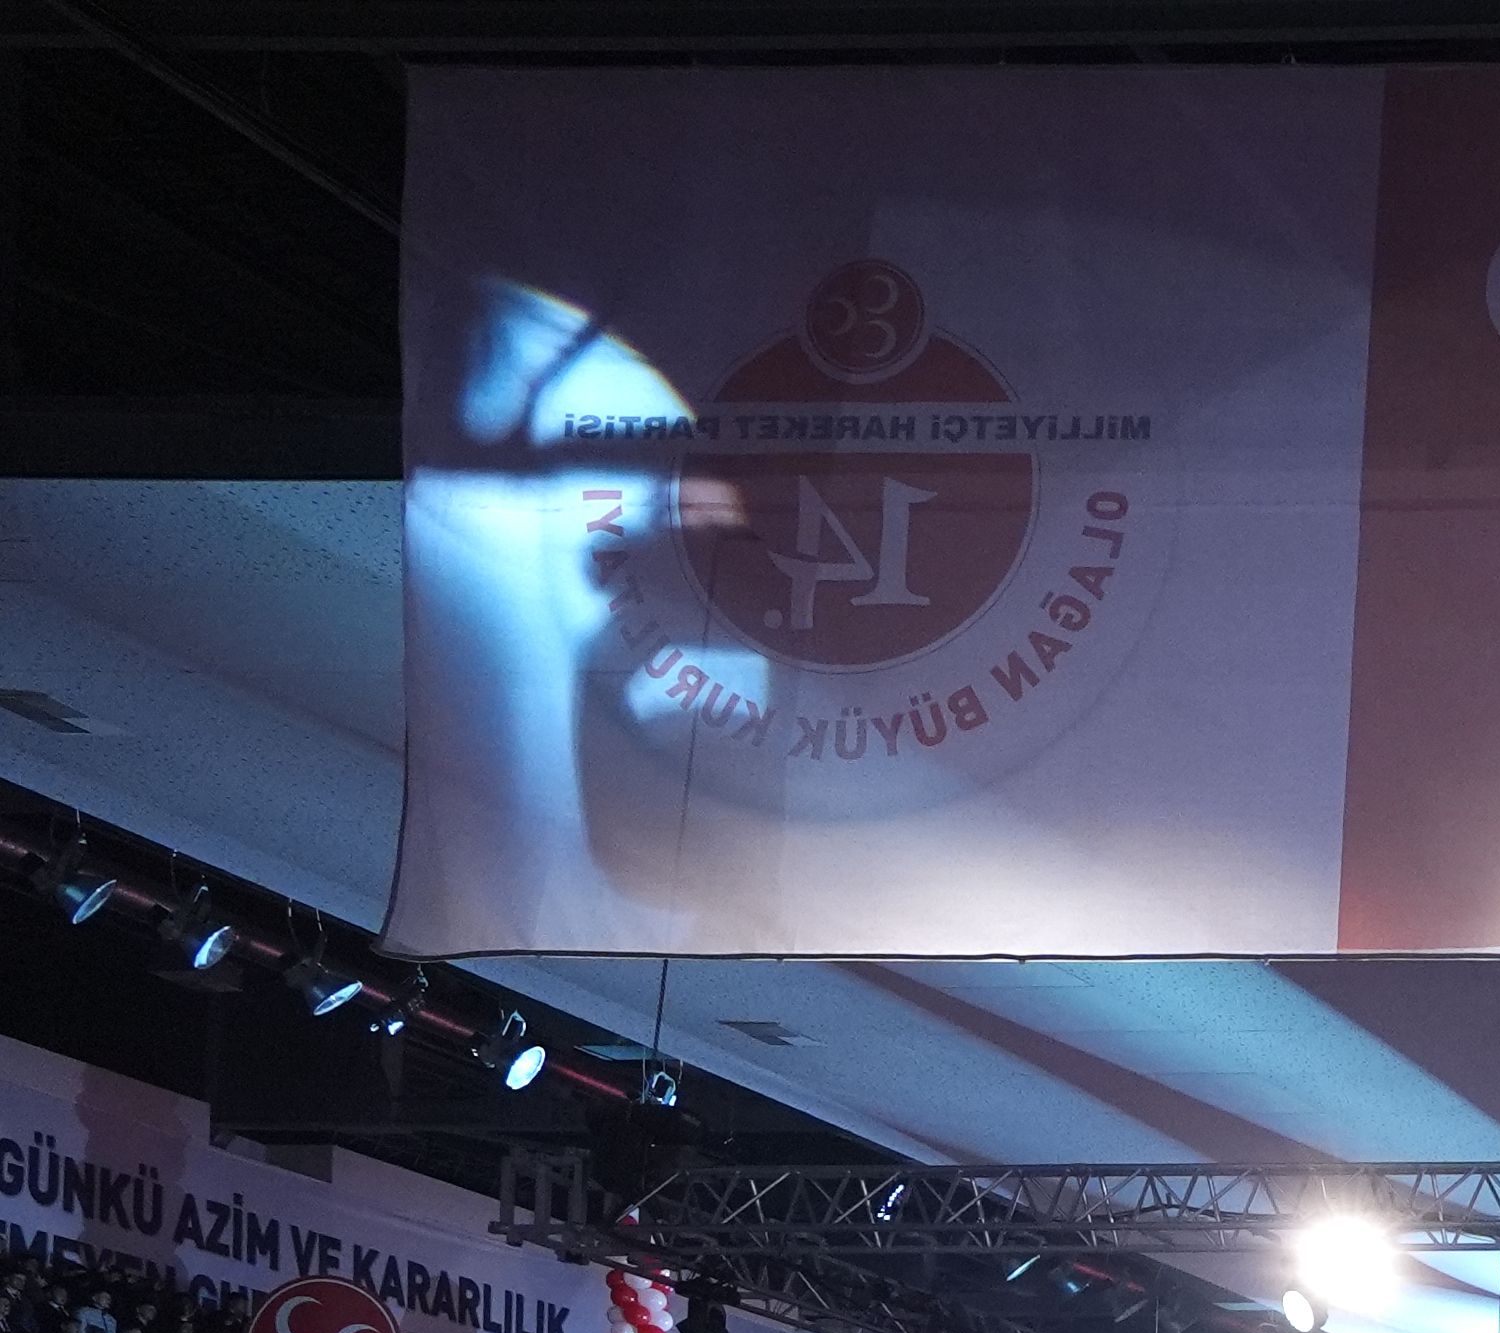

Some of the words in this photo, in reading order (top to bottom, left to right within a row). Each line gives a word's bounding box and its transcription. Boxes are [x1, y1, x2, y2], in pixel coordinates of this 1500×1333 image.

[0, 1130, 163, 1237] GÜNKÜ
[173, 1192, 280, 1272] AZİM
[288, 1223, 343, 1278] VE
